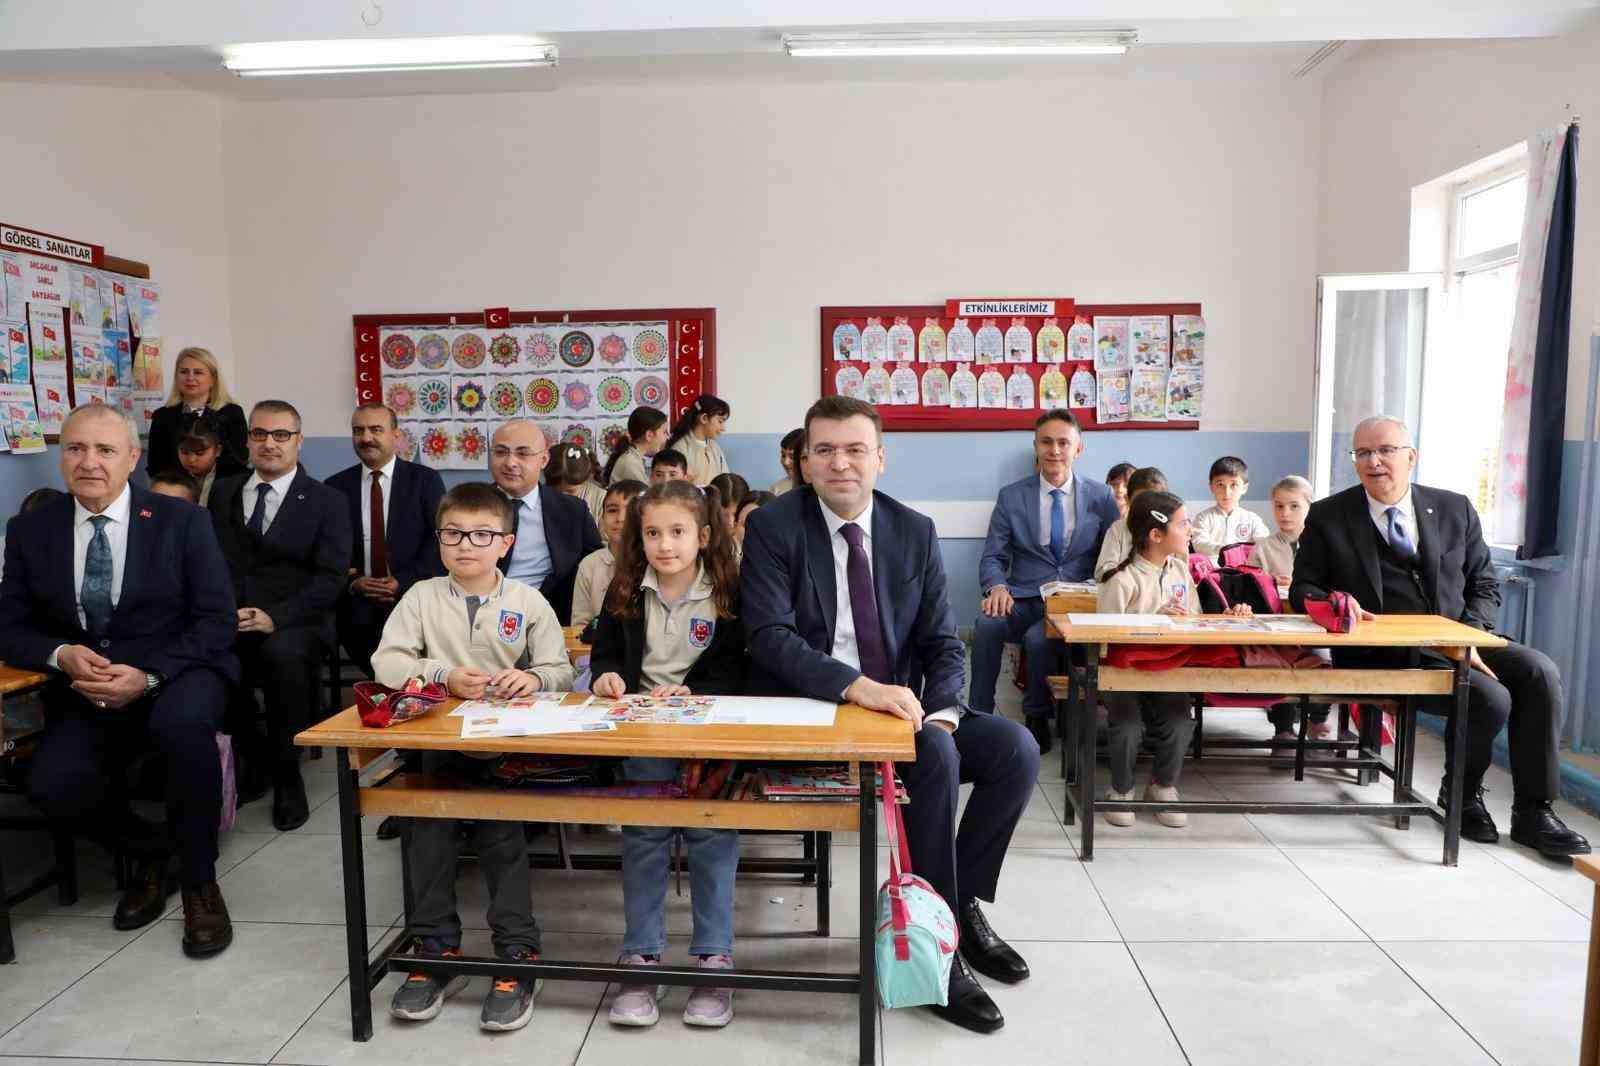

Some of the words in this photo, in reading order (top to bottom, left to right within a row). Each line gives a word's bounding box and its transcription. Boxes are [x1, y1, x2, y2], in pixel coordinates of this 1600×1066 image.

[5, 231, 41, 249] GÖRSEL
[46, 240, 90, 260] SANATLAR
[965, 302, 1048, 313] ETKİNLİKLERİMİZ
